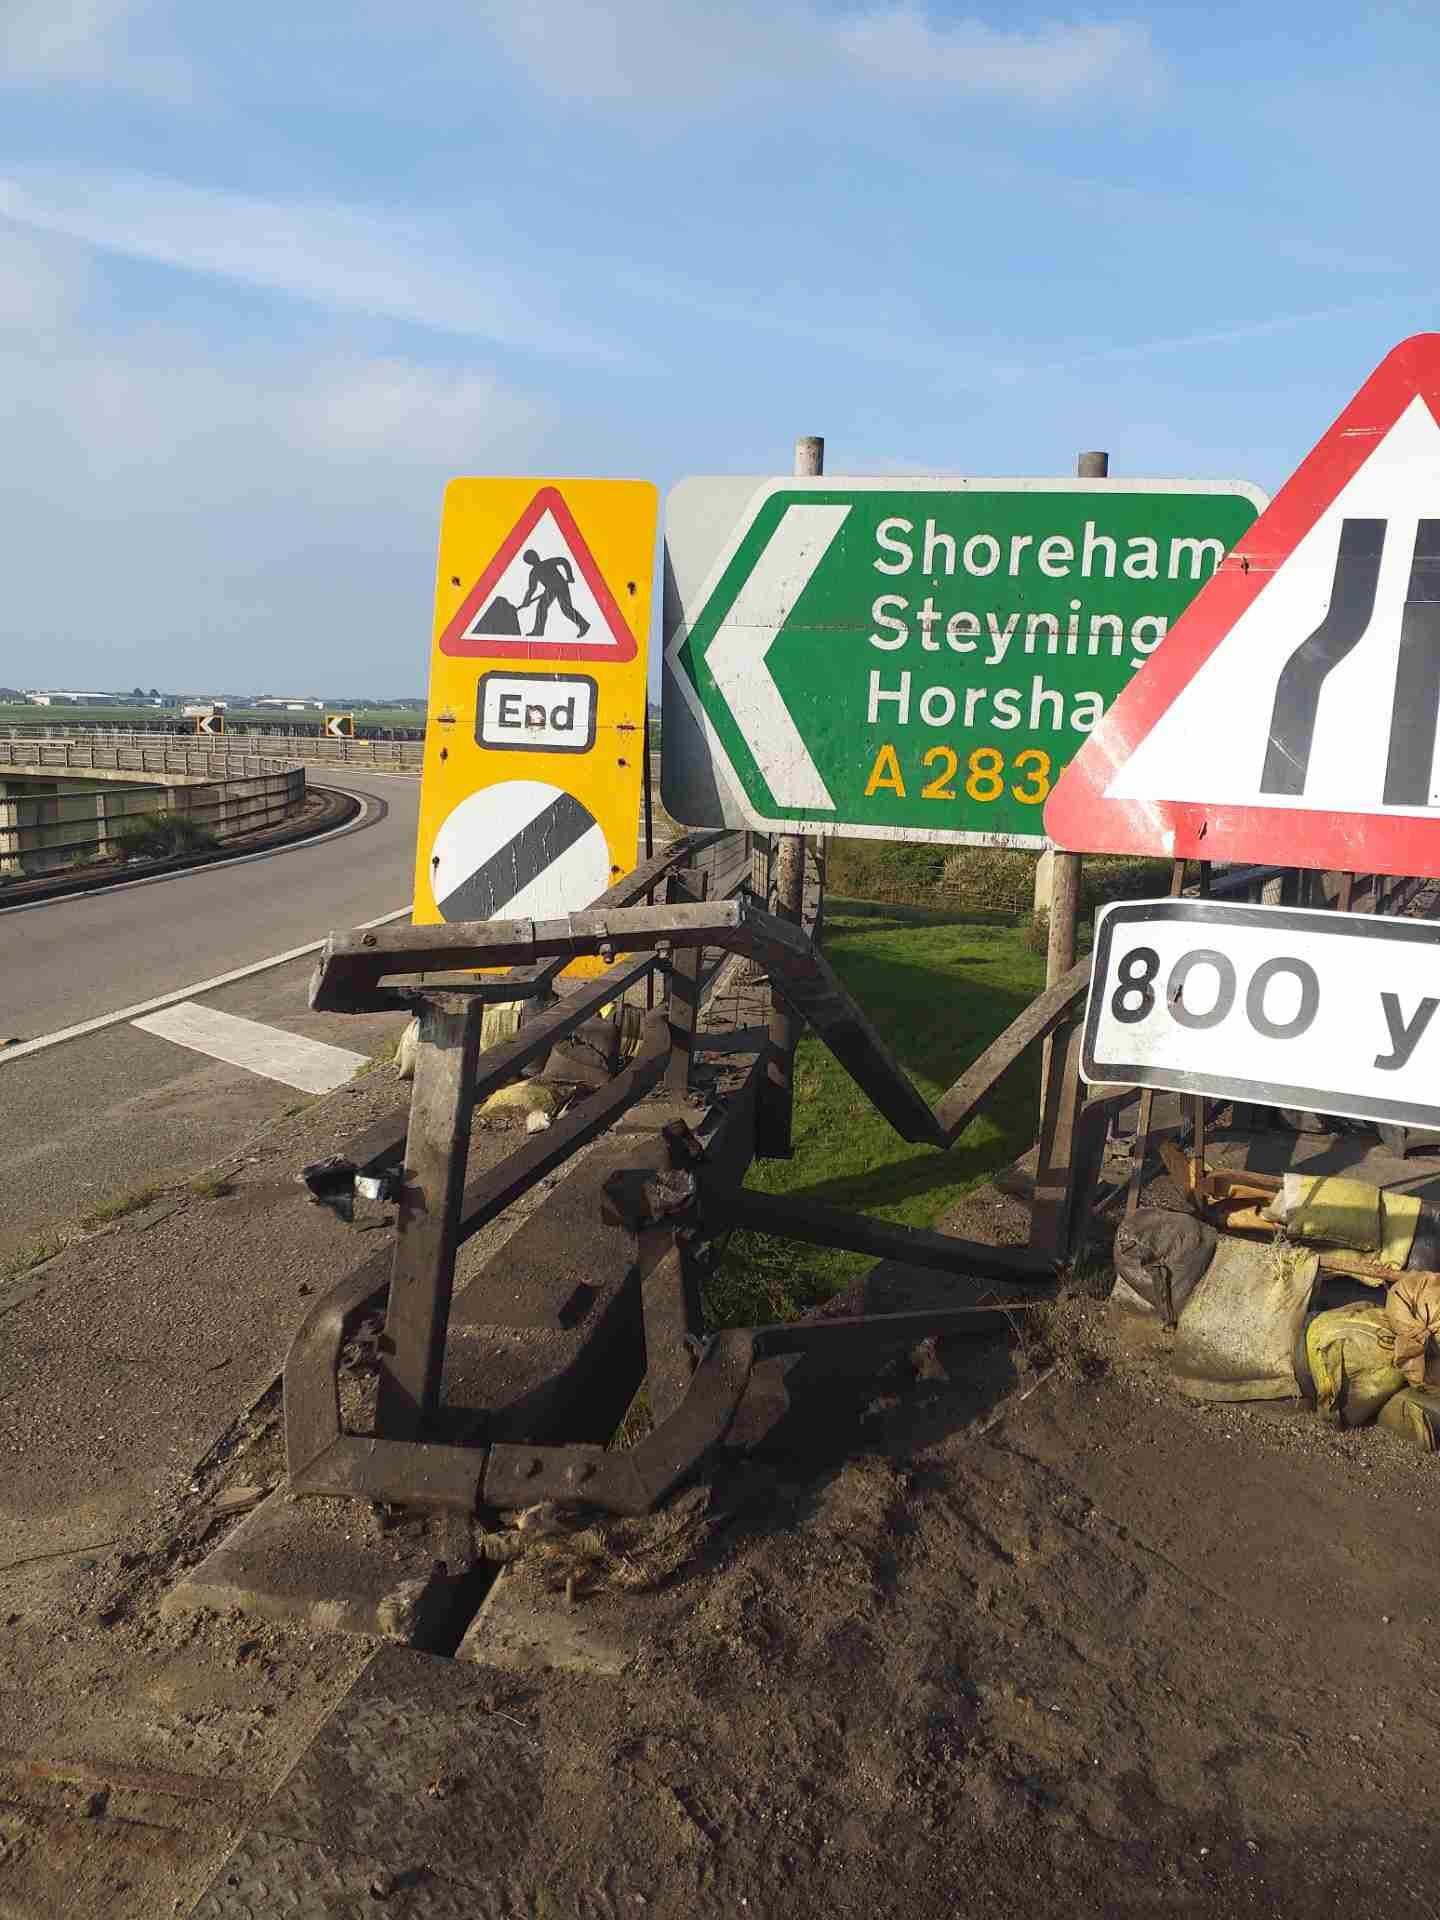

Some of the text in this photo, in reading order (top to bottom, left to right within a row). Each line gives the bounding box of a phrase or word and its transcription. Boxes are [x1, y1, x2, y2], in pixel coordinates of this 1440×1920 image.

[872, 516, 1226, 580] Shoreham
[868, 594, 1169, 669] Steyning
[498, 693, 576, 731] End
[866, 669, 1120, 733] Horsha
[1111, 946, 1321, 1040] 800
